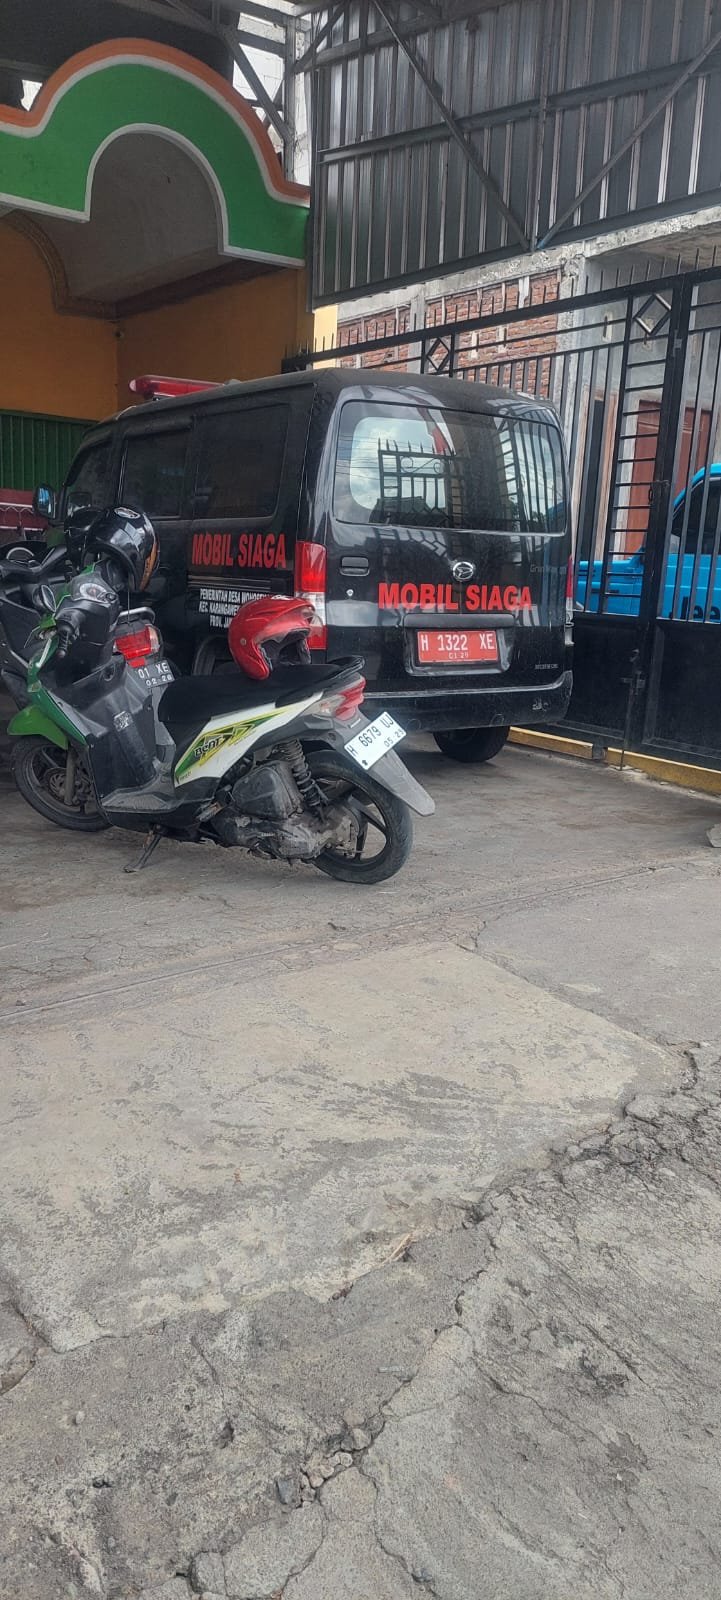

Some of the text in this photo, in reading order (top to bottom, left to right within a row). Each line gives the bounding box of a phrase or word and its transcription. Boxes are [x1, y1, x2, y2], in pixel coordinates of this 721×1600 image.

[191, 532, 287, 569] MOBIL SIAGA
[378, 582, 533, 611] MOBIL SIAGA
[420, 633, 495, 651] H 1322 XE
[155, 662, 169, 674] XE
[346, 714, 394, 757] H 6679 UJ
